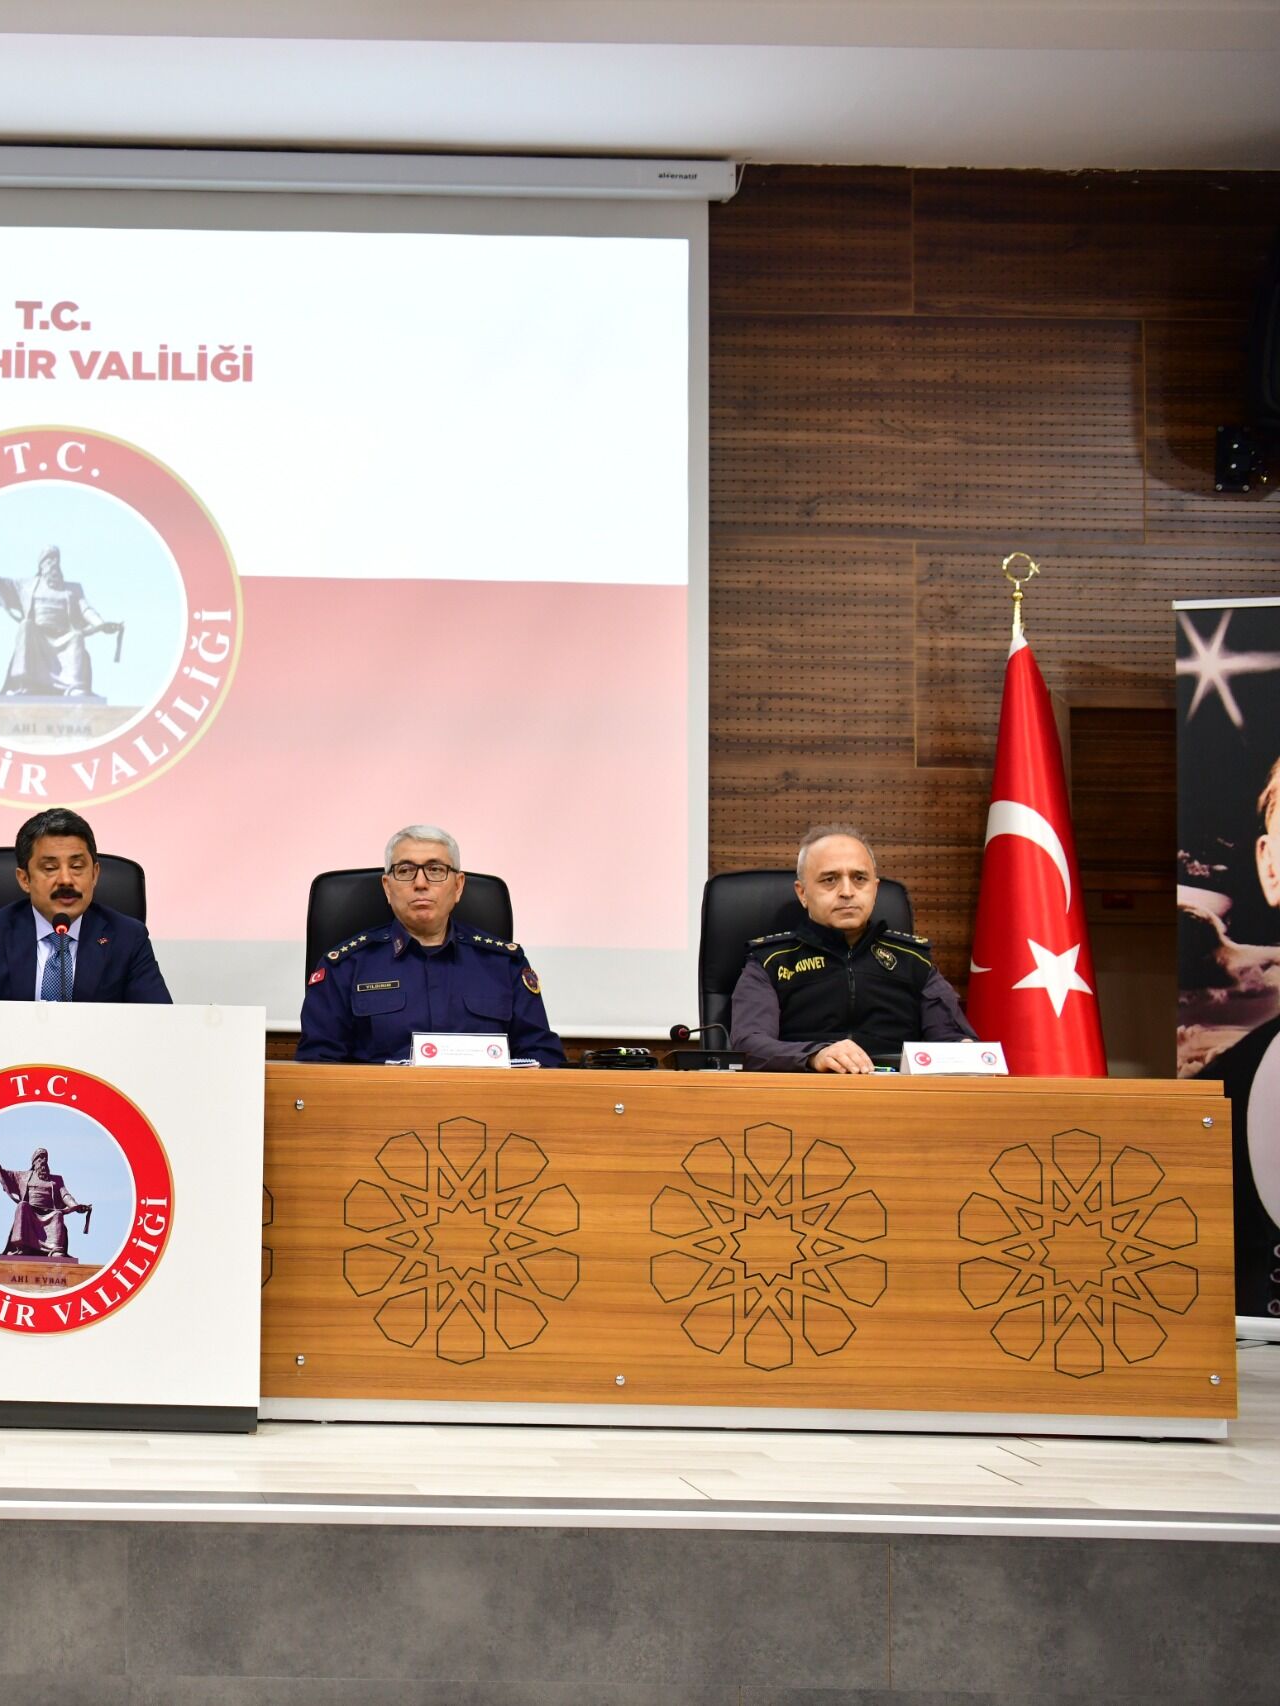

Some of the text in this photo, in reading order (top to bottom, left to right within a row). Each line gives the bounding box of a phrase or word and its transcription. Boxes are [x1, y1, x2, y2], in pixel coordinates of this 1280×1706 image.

[657, 172, 698, 180] alternatif
[15, 301, 91, 331] T.C.
[70, 344, 254, 382] VALİLİĞİ
[4, 441, 100, 478] T.C.
[71, 608, 231, 792] VALİLİĞİ
[10, 1075, 77, 1101] T.C.
[52, 1196, 168, 1325] VALİLİĞİ
